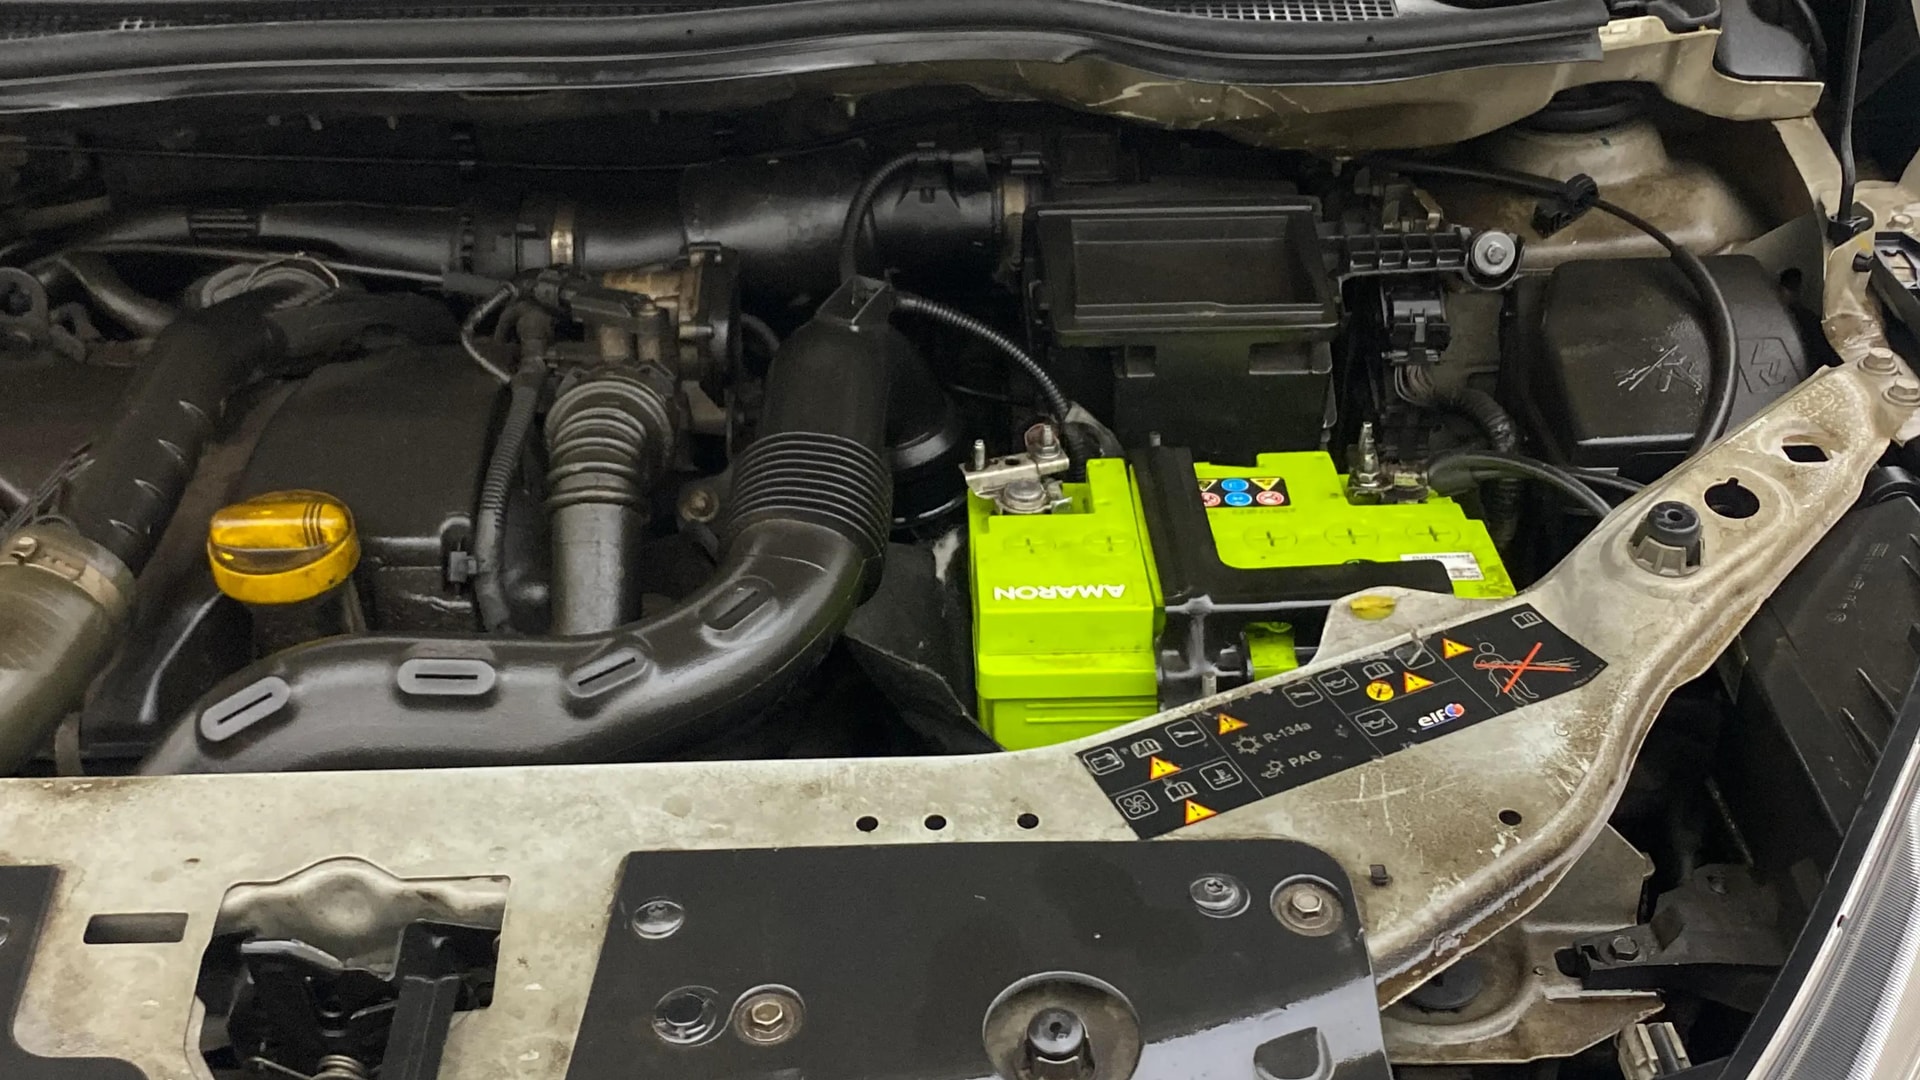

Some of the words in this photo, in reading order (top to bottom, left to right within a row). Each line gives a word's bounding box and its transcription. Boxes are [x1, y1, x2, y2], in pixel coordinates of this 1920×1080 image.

[993, 584, 1125, 601] AMARON
[1417, 708, 1446, 727] elf
[1262, 722, 1312, 743] R-134a
[1287, 750, 1322, 767] PAG
